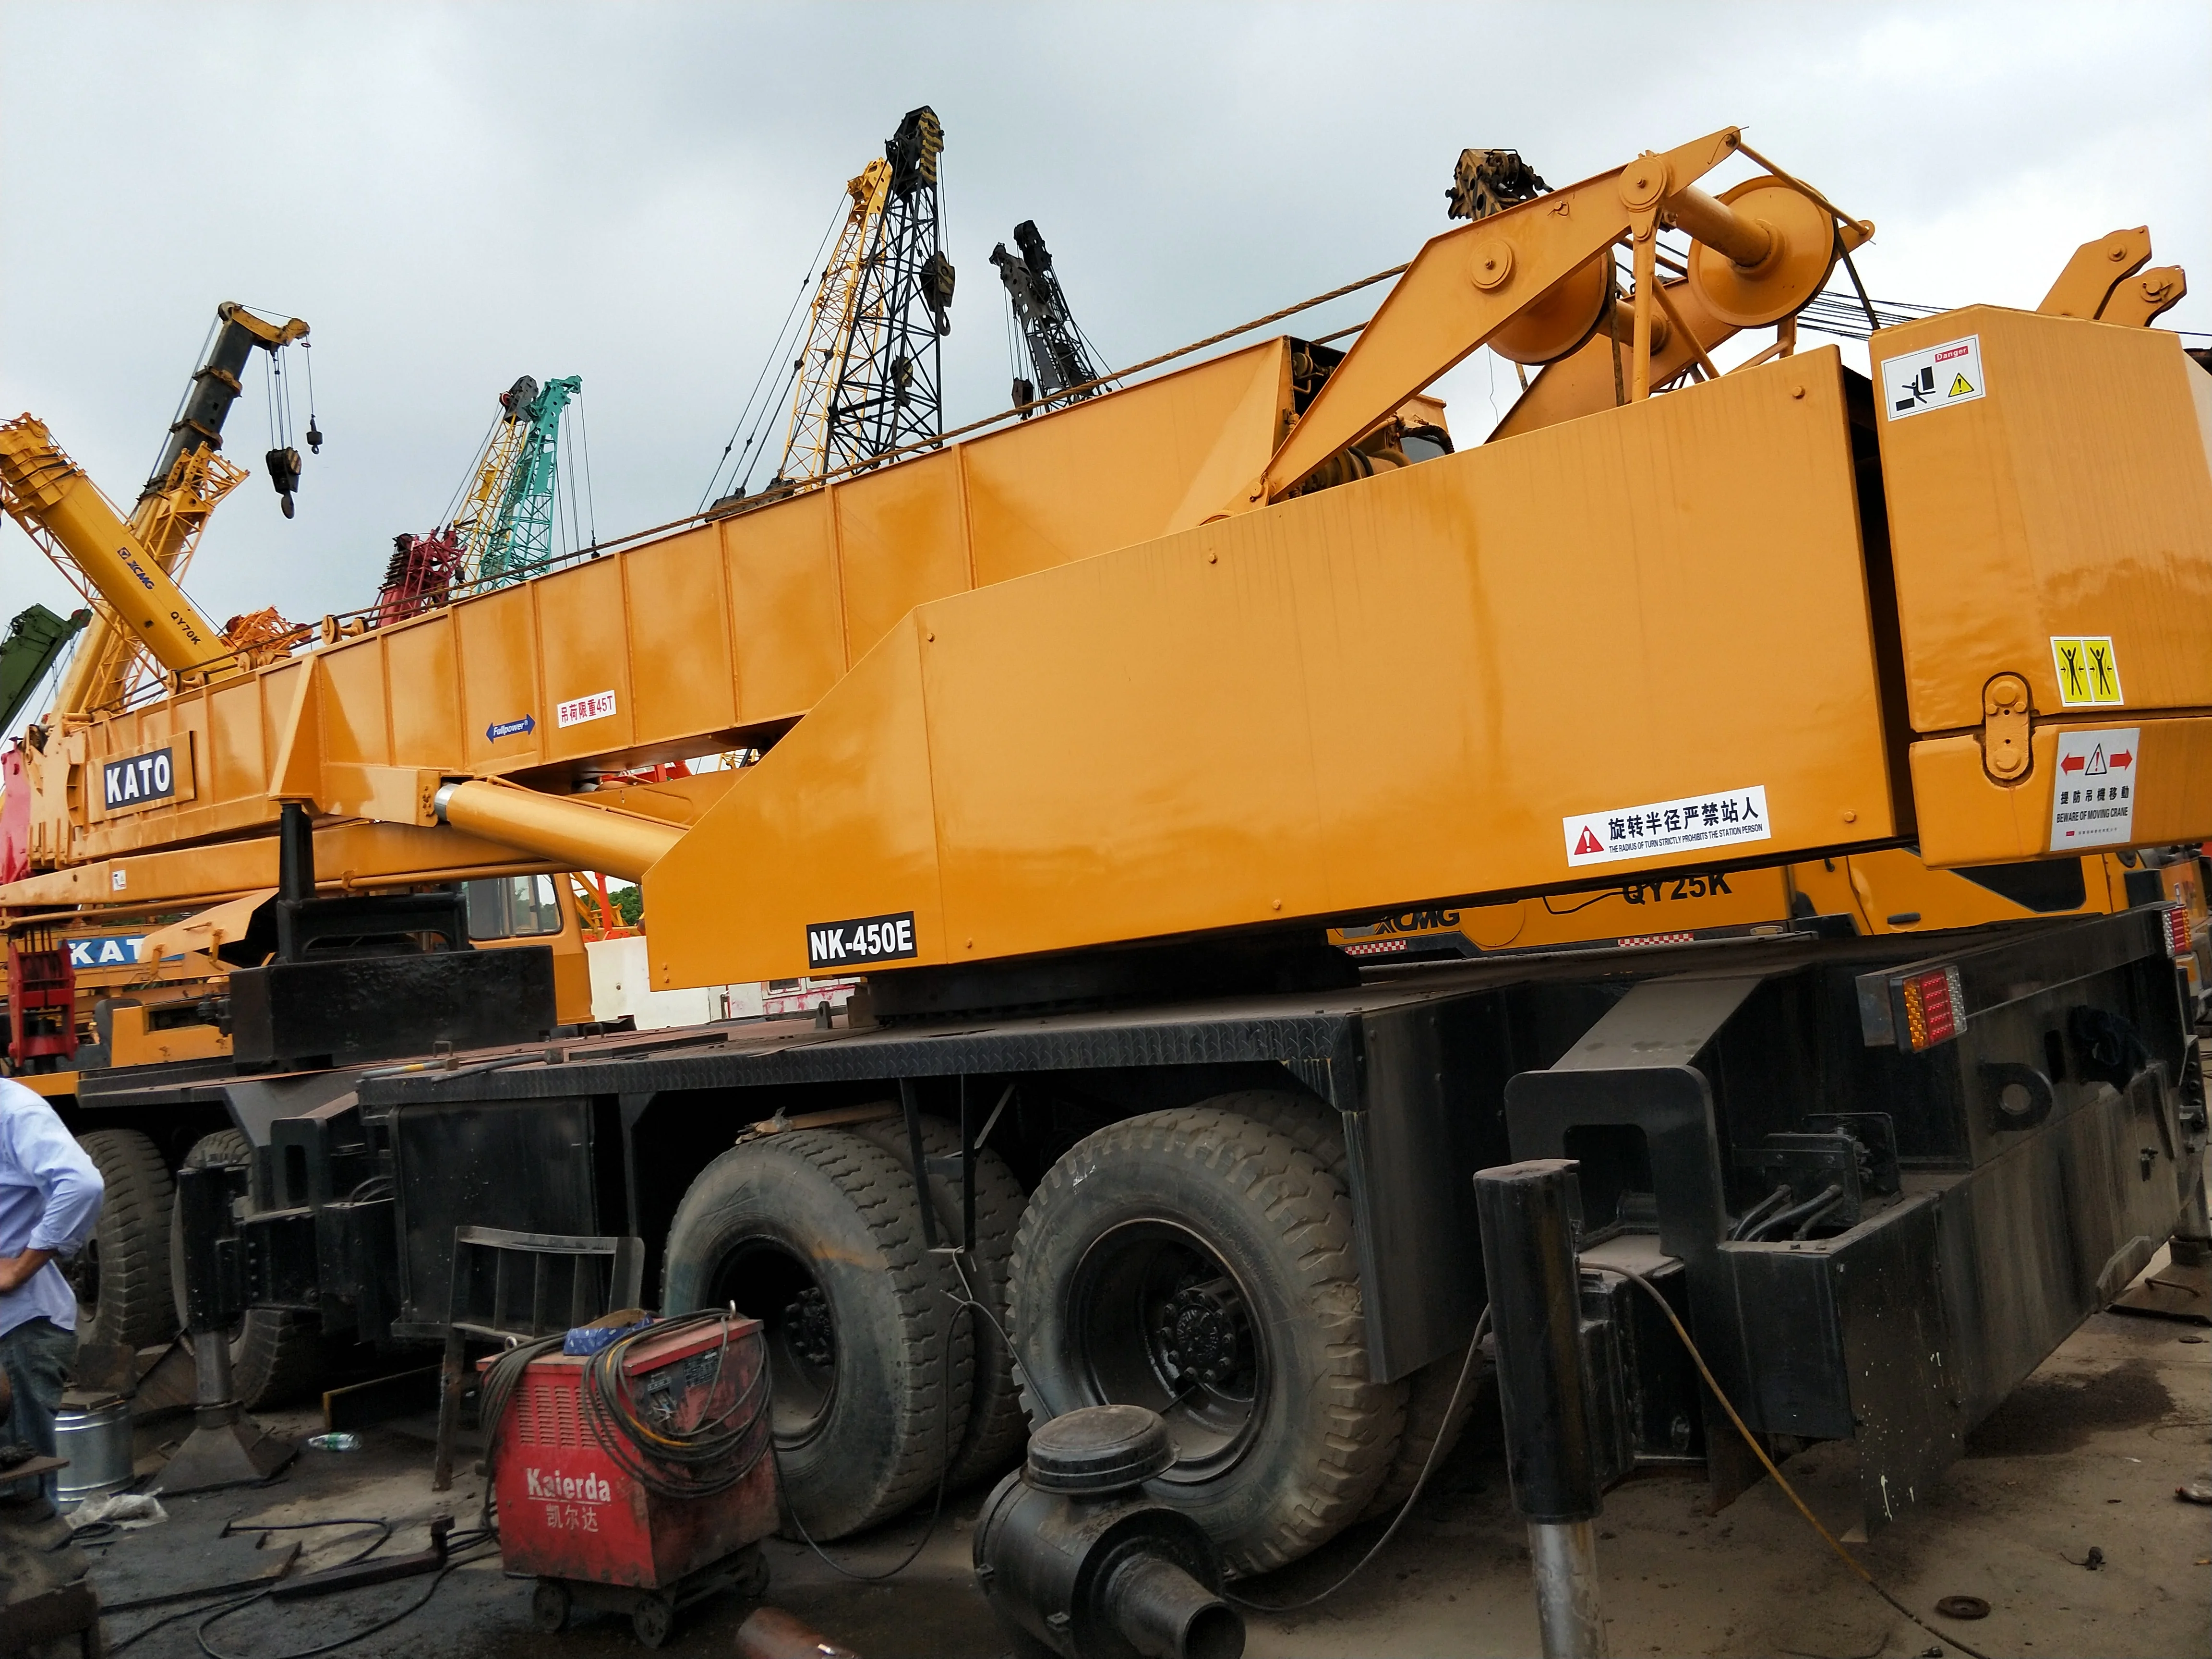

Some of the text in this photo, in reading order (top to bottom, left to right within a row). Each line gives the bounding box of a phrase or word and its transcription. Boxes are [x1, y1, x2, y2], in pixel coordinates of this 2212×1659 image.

[1937, 348, 1967, 361] Danger
[126, 560, 155, 589] XCMG
[170, 611, 201, 645] QY70K
[561, 695, 613, 723] 吊荷限重45T
[106, 755, 170, 804] KATO
[2060, 785, 2129, 805] 提防吊機移動
[1608, 797, 1759, 841] 旋转半径严禁站人
[2056, 807, 2128, 823] BEWARE OF MOVING CRANE
[1609, 845, 1619, 854] THE
[1619, 843, 1637, 852] RADIUS
[1645, 839, 1659, 849] TURN
[1659, 835, 1682, 846] STRICTLY
[1682, 832, 1708, 843] PROHIBITS
[1708, 830, 1719, 839] THE
[1719, 827, 1742, 838] STATION
[1742, 823, 1763, 834] PERSON
[1623, 872, 1732, 905] QY25K
[69, 938, 144, 965] KAT
[810, 919, 913, 961] NK-450E
[526, 1467, 611, 1502] Kaierda
[546, 1503, 599, 1532] 凯尔达
